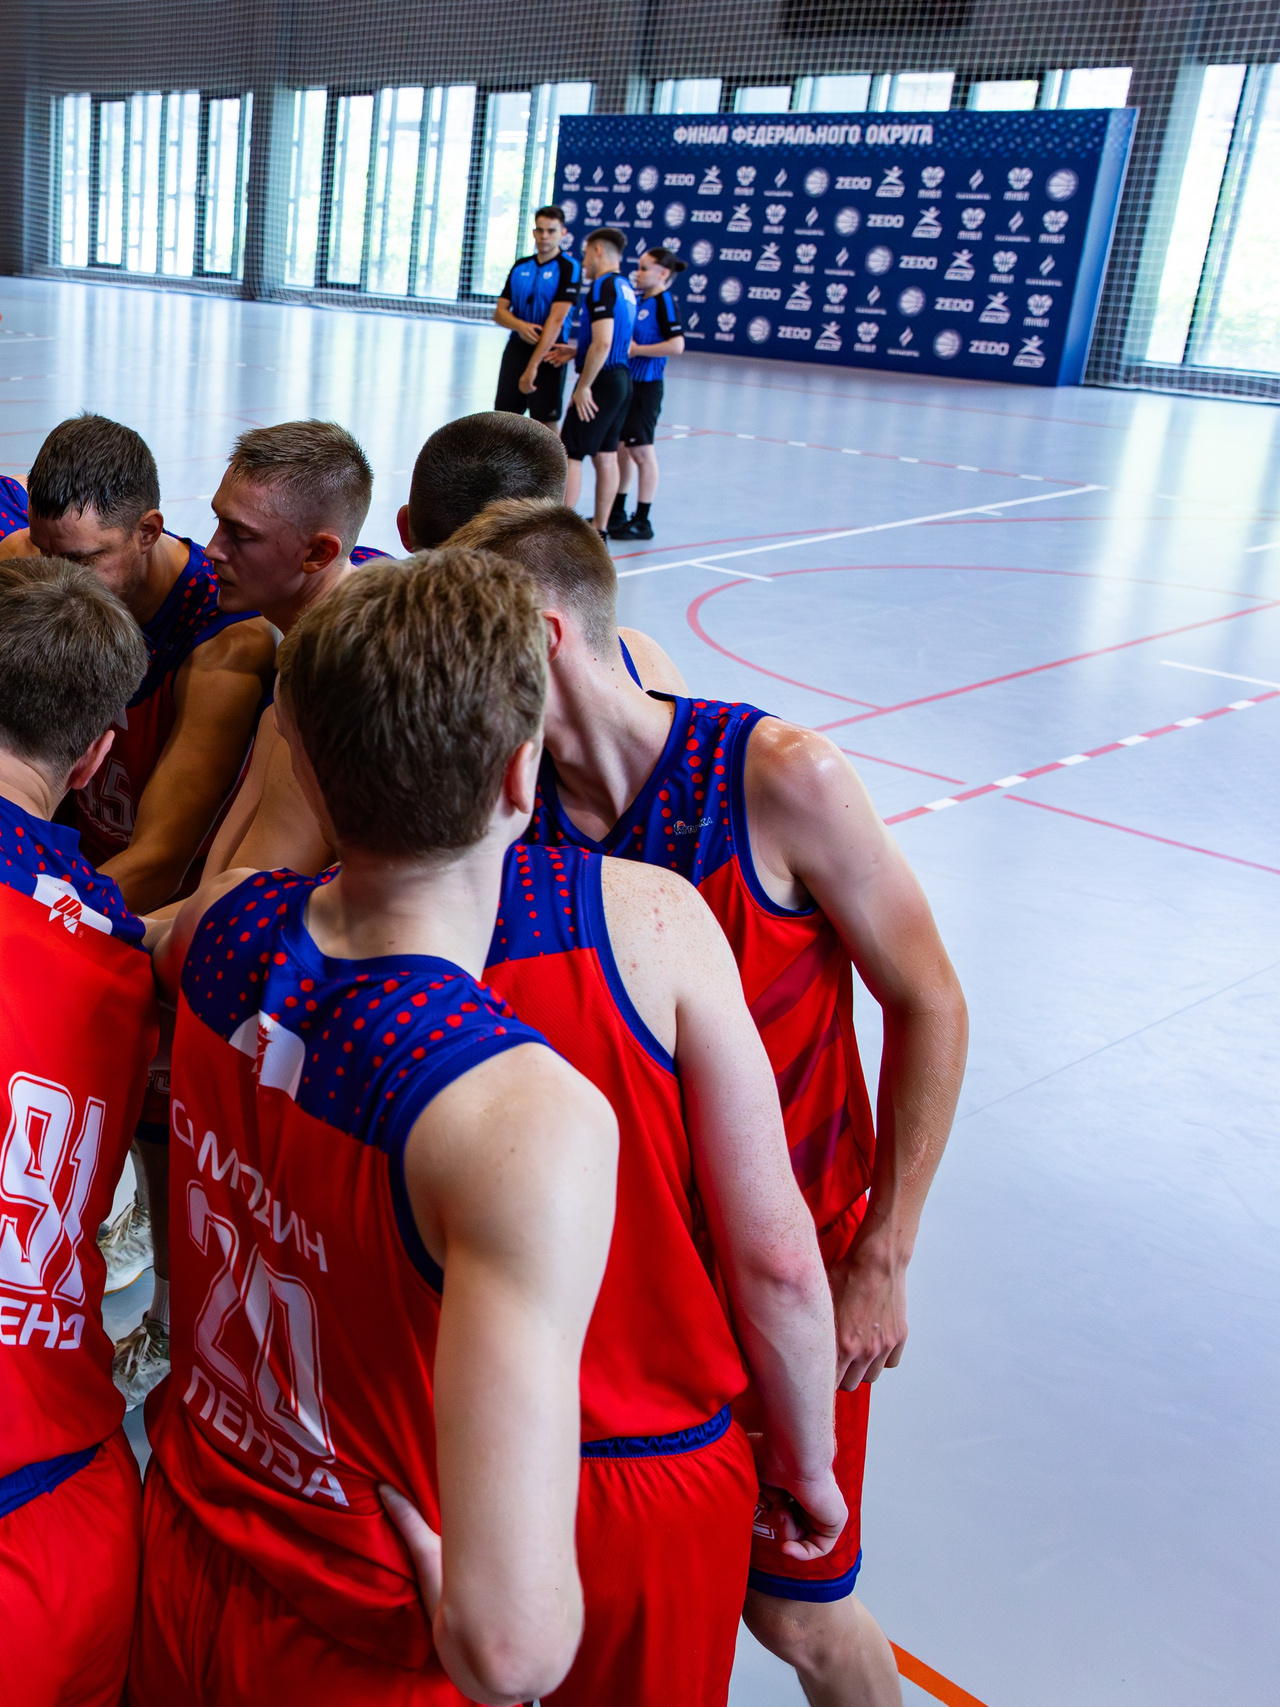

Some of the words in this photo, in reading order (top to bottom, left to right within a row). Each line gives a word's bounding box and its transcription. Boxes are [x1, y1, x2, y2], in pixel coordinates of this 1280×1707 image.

[674, 125, 729, 145] ФИНАЛ
[731, 124, 861, 147] ФЕДЕРАЛЬНОГО
[865, 123, 933, 145] ОКРУГА
[664, 173, 696, 187] ZEDO
[835, 176, 872, 190] ZEDO
[690, 209, 723, 223] ZEDO
[866, 214, 905, 228] ZEDO
[719, 248, 753, 262] ZEDO
[899, 254, 938, 270] ZEDO
[747, 286, 782, 301] ZEDO
[934, 296, 975, 313] ZEDO
[777, 325, 812, 340] ZEDO
[968, 339, 1010, 356] ZEDO
[186, 1179, 337, 1464] 20
